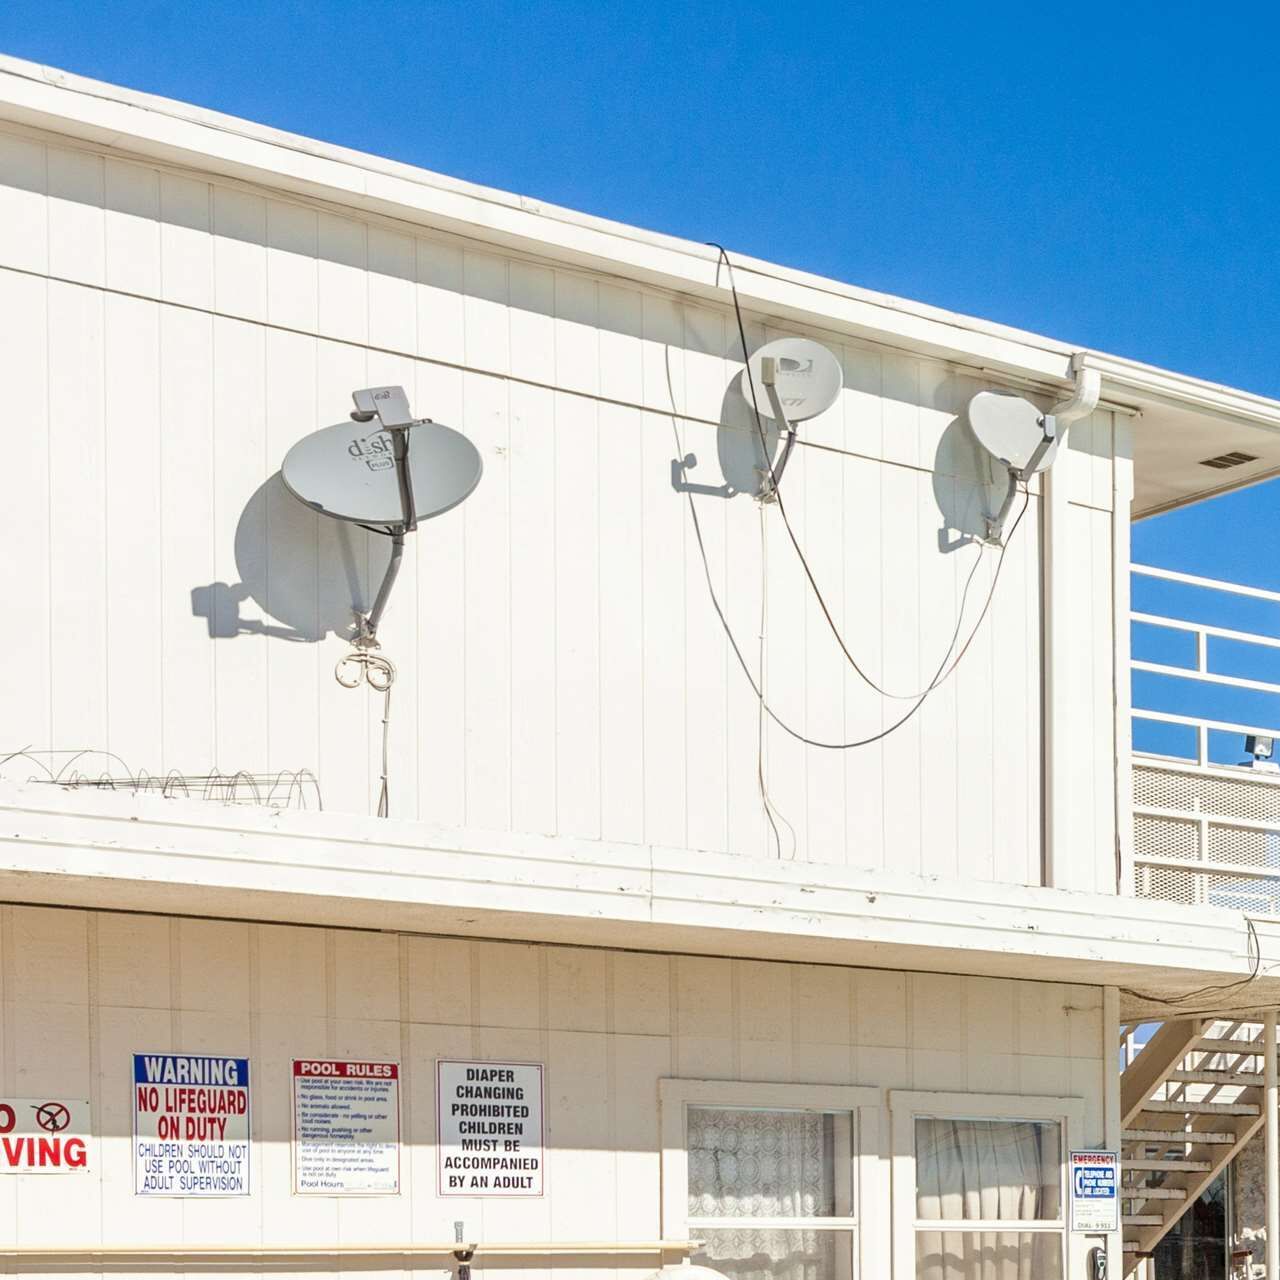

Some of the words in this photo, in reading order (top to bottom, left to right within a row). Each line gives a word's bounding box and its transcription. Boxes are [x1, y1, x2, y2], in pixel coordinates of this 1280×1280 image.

[144, 1056, 239, 1086] WARNING
[301, 1062, 340, 1075] POOL
[346, 1064, 392, 1077] RULES
[466, 1068, 514, 1083] DIAPER
[456, 1085, 524, 1100] CHANGING
[138, 1087, 159, 1112] NO
[165, 1088, 247, 1115] LIFEGUARD
[452, 1103, 529, 1118] PROHIBITED
[0, 1104, 16, 1133] O
[158, 1115, 180, 1141] ON
[186, 1116, 227, 1141] DUTY
[459, 1121, 523, 1135] CHILDREN
[2, 1137, 87, 1167] VING
[138, 1143, 184, 1158] CHILDREN
[188, 1144, 225, 1159] SHOULD
[229, 1145, 247, 1159] NOT
[461, 1139, 499, 1152] MUST
[504, 1140, 520, 1152] BE
[444, 1156, 538, 1170] ACCOMPANIED
[1073, 1155, 1114, 1164] EMERGENCY
[145, 1160, 163, 1174] USE
[169, 1160, 195, 1174] POOL
[199, 1160, 242, 1175] WITHOUT
[144, 1175, 174, 1190] ADULT
[180, 1176, 243, 1191] SUPERVISION
[320, 1180, 344, 1188] Hours
[449, 1175, 465, 1188] BY
[470, 1176, 488, 1188] AN
[493, 1176, 533, 1188] ADULT
